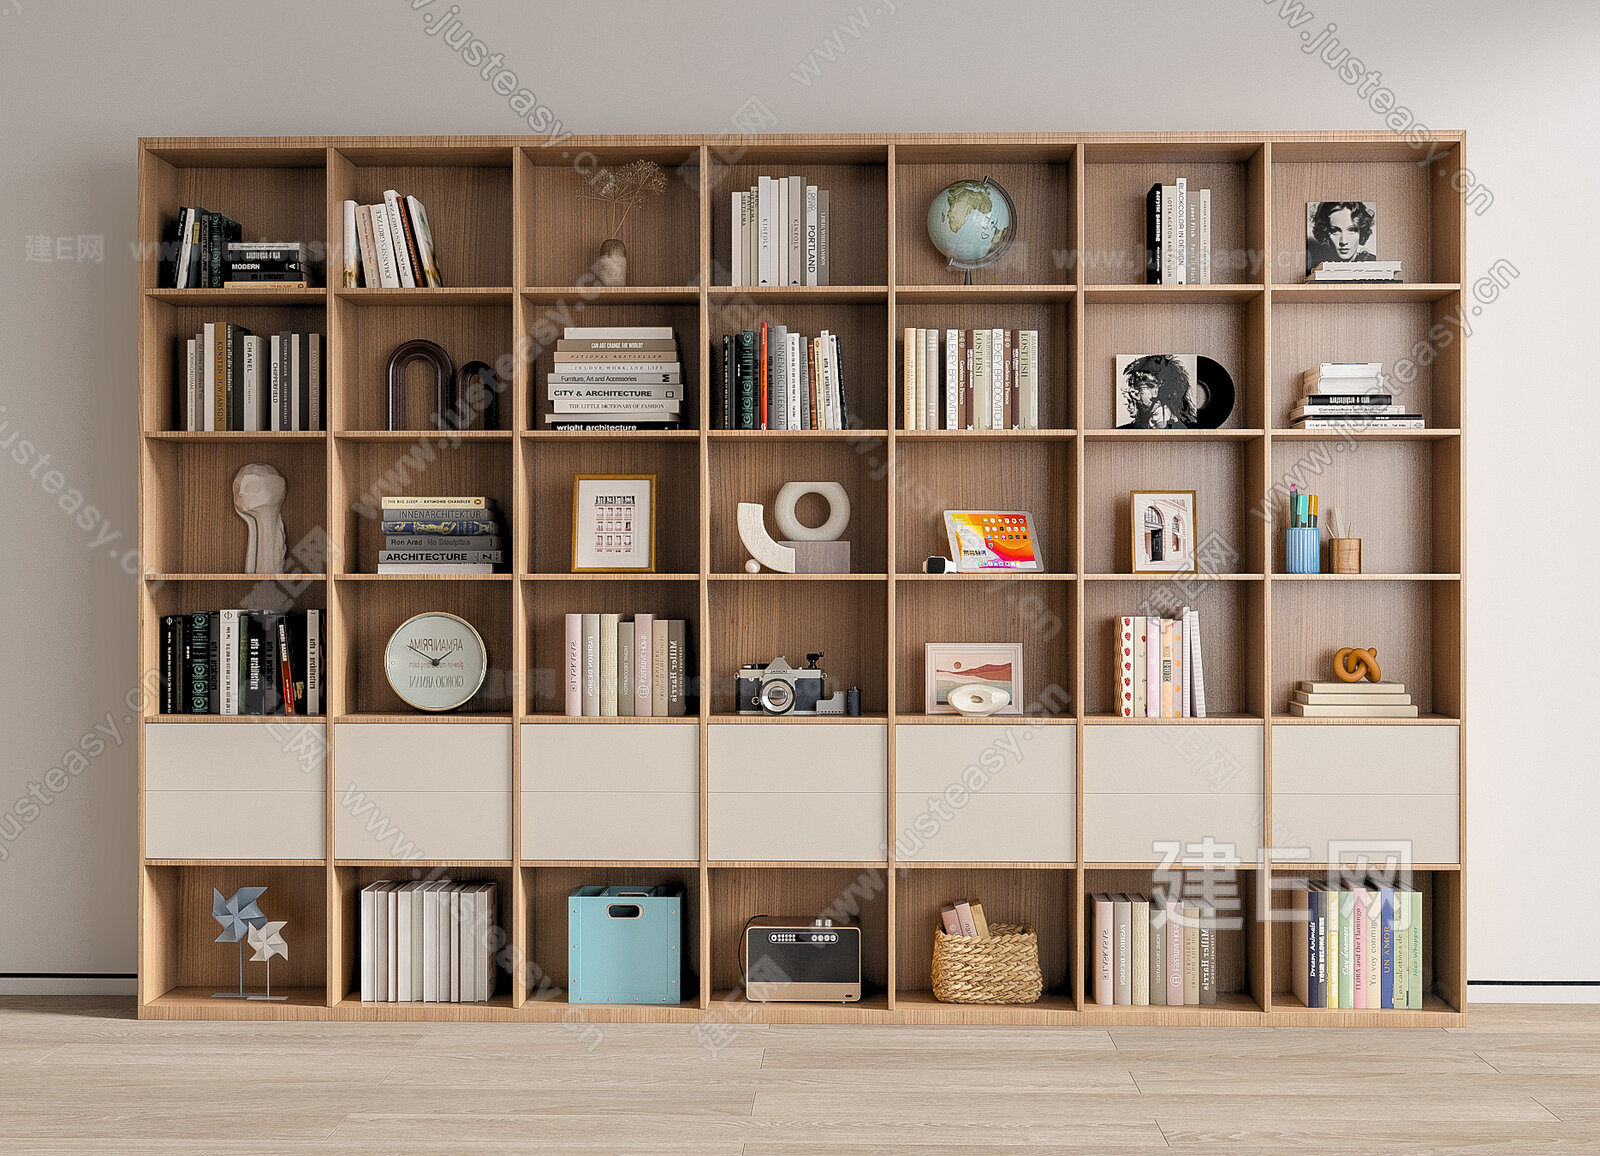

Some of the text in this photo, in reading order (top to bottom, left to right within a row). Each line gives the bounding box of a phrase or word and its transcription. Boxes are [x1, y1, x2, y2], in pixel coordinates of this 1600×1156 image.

[994, 332, 1002, 366] ALEXEY
[948, 332, 956, 426] ALEXEY BRODOVITCH
[1341, 926, 1349, 958] dreamers
[1396, 934, 1403, 944] de
[1384, 959, 1390, 973] UN
[1369, 975, 1376, 986] Yo
